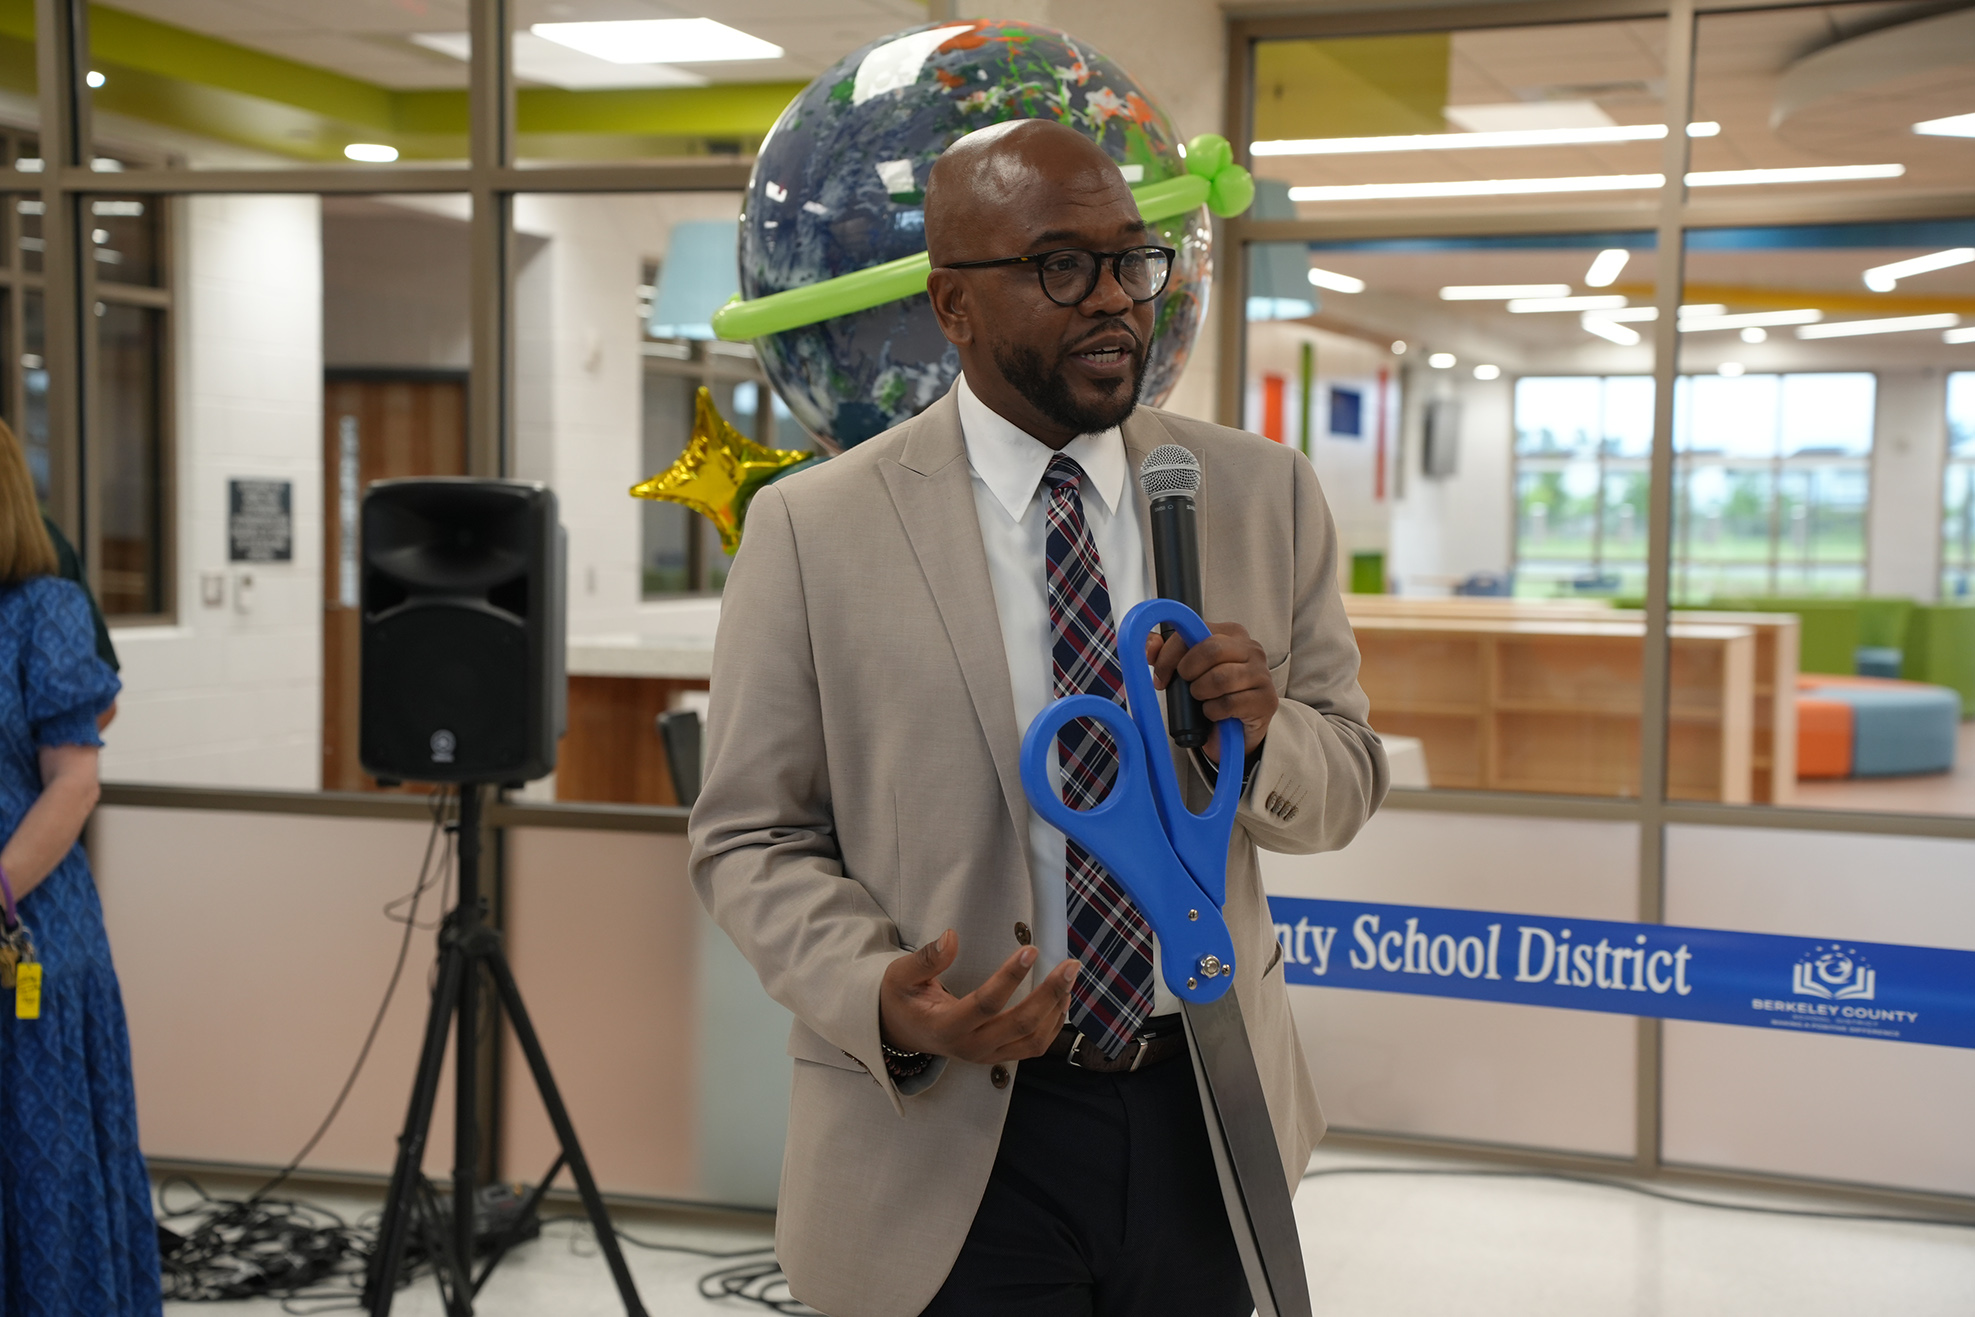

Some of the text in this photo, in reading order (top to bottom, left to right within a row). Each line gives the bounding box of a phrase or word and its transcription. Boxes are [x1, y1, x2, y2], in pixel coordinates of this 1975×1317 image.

[1273, 913, 1692, 996] nty School District
[1752, 999, 1919, 1024] BERKELEY COUNTY
